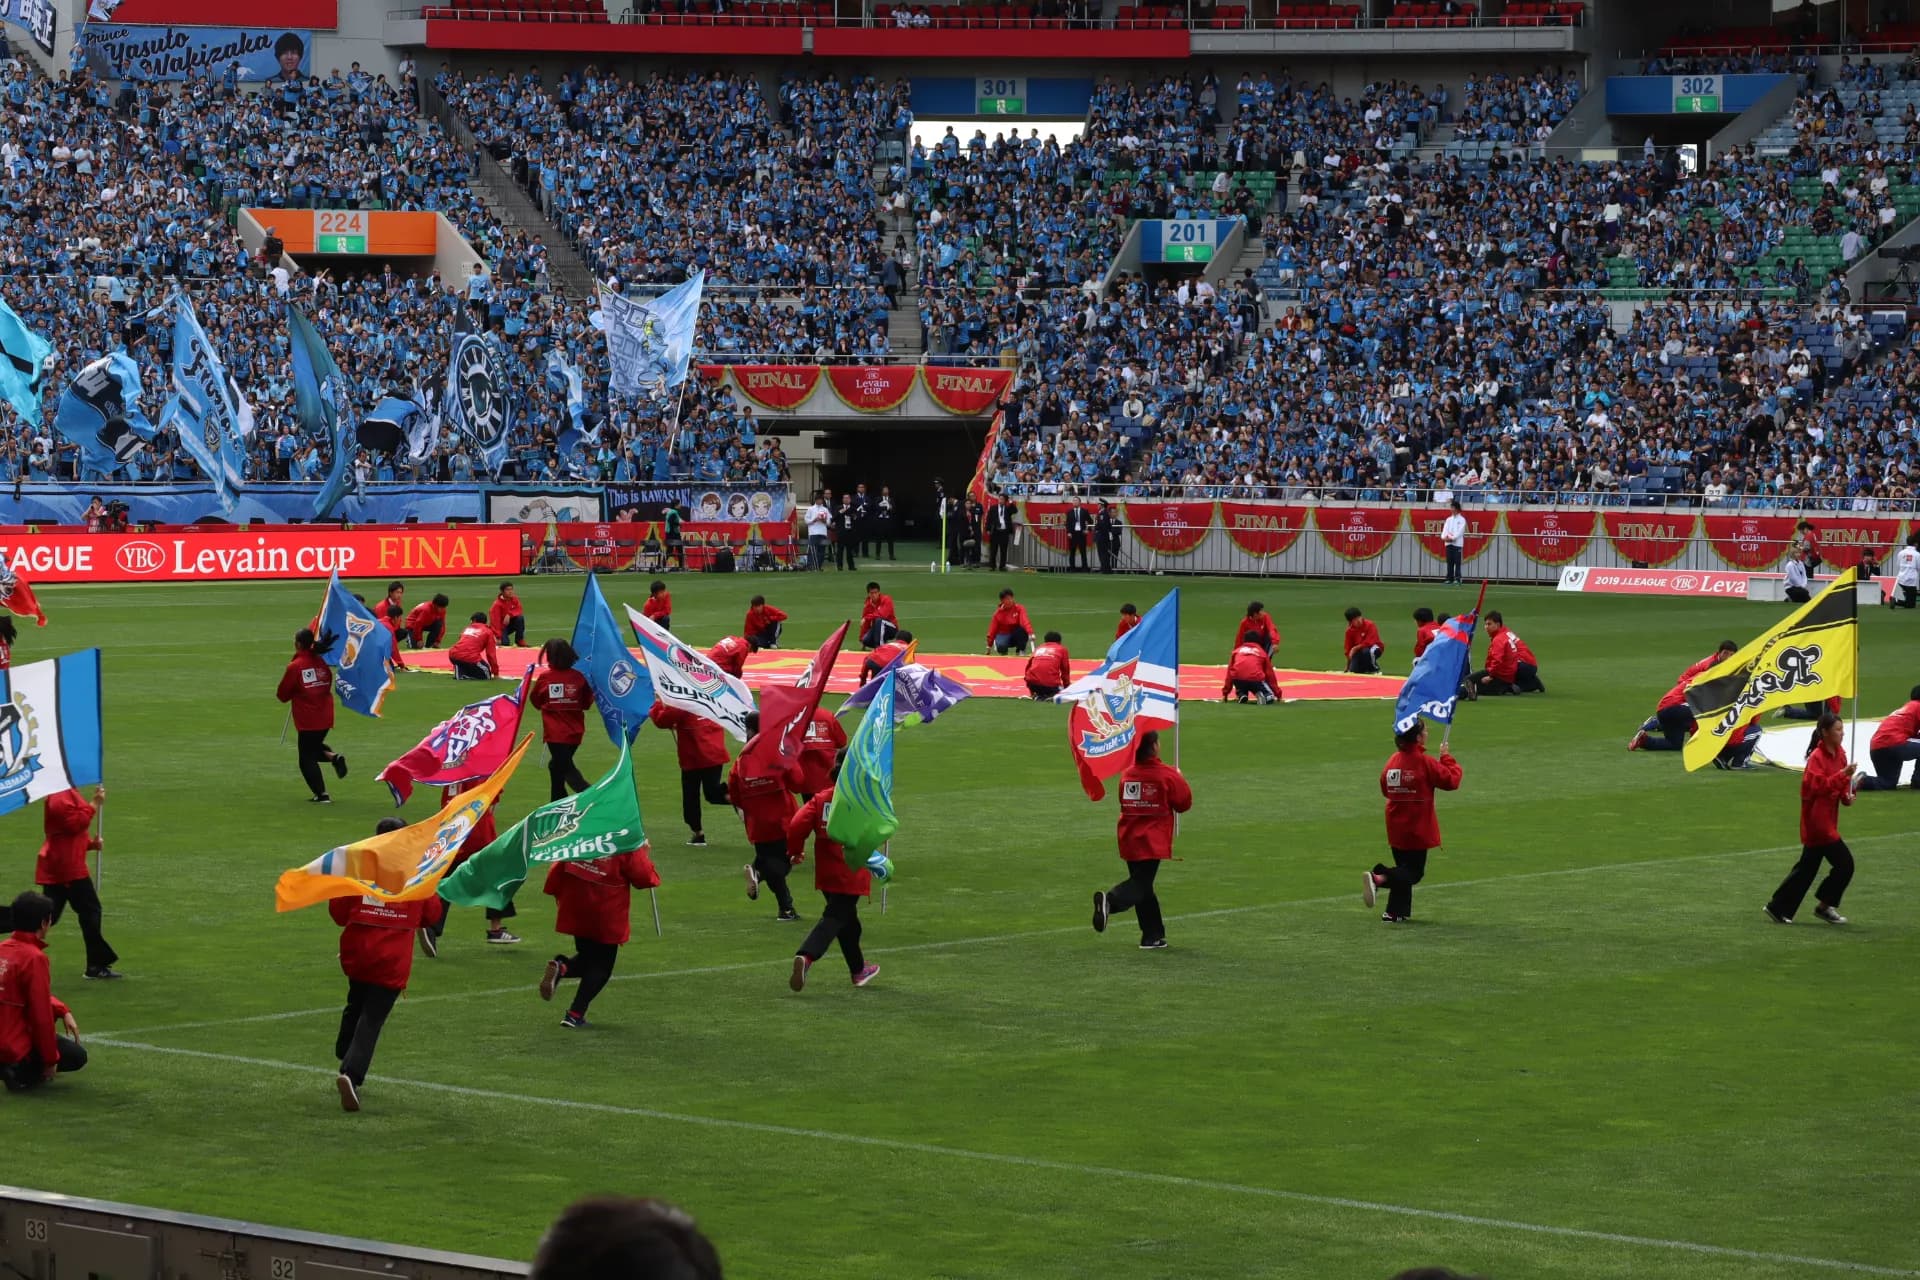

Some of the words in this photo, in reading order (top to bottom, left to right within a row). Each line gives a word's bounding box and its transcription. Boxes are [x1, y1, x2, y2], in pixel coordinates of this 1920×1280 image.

[84, 27, 129, 46] Prince
[104, 28, 189, 73] Yasuto
[140, 32, 272, 76] Wakizaka
[983, 79, 1016, 96] 301
[1681, 77, 1714, 94] 302
[320, 212, 362, 232] 224
[1170, 223, 1205, 242] 201
[747, 372, 806, 390] FINAL
[855, 378, 890, 389] Levain
[936, 374, 996, 393] FINAL
[607, 488, 629, 508] This
[630, 489, 639, 504] is
[1162, 529, 1180, 537] CUP
[1234, 514, 1291, 533] FINAL
[1618, 523, 1679, 541] FINAL
[1348, 534, 1366, 542] CUP
[1542, 538, 1560, 546] CUP
[1741, 543, 1759, 551] CUP
[1821, 528, 1884, 547] FINAL
[123, 547, 158, 568] YBC
[172, 537, 289, 573] Levain
[295, 547, 355, 572] CUP
[377, 535, 497, 569] FINAL
[1595, 577, 1619, 585] 2019
[1620, 578, 1667, 587] J.LEAGUE
[1674, 577, 1696, 588] YBC
[27, 1220, 46, 1240] 33
[272, 1258, 294, 1279] 32
